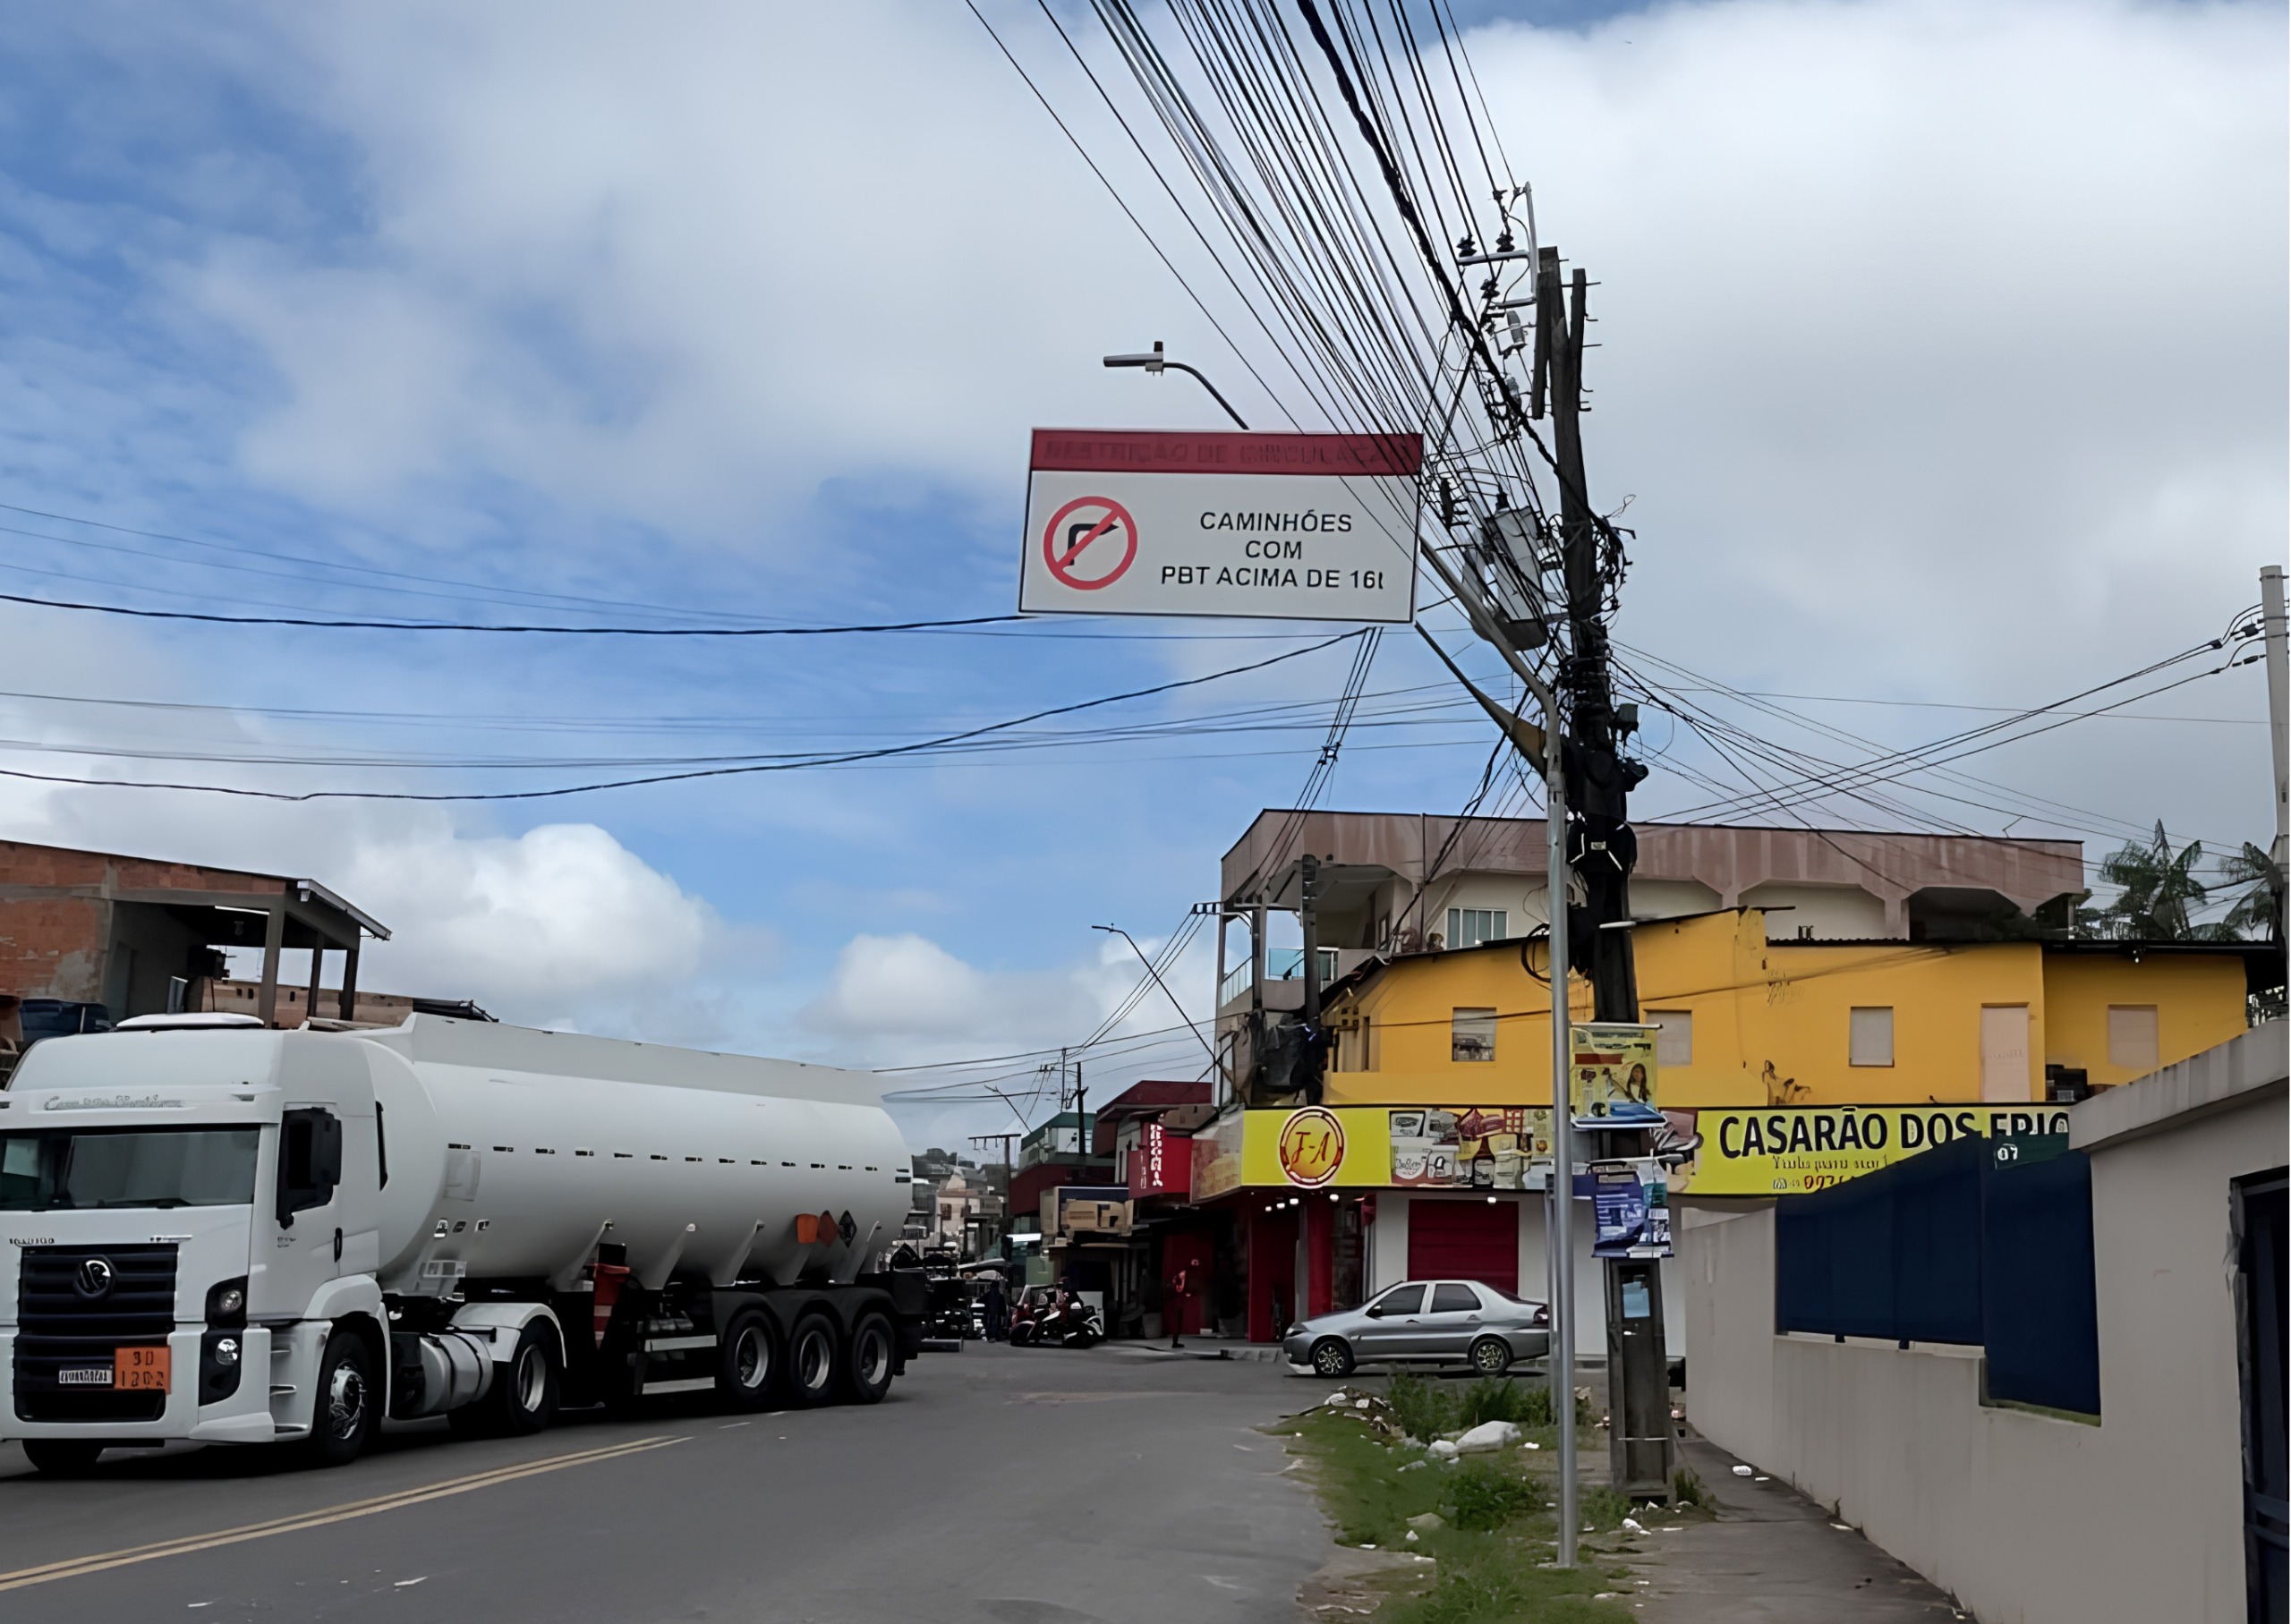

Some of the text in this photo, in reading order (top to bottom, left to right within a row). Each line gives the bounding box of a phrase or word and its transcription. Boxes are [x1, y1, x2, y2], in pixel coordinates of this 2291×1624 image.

[1245, 540, 1302, 560] COM
[1161, 565, 1211, 585] PBT
[1215, 565, 1299, 587] ACIMA
[1306, 568, 1341, 589] DE
[1718, 1106, 1889, 1160] CASARÃO
[1900, 1111, 1976, 1151] DOS
